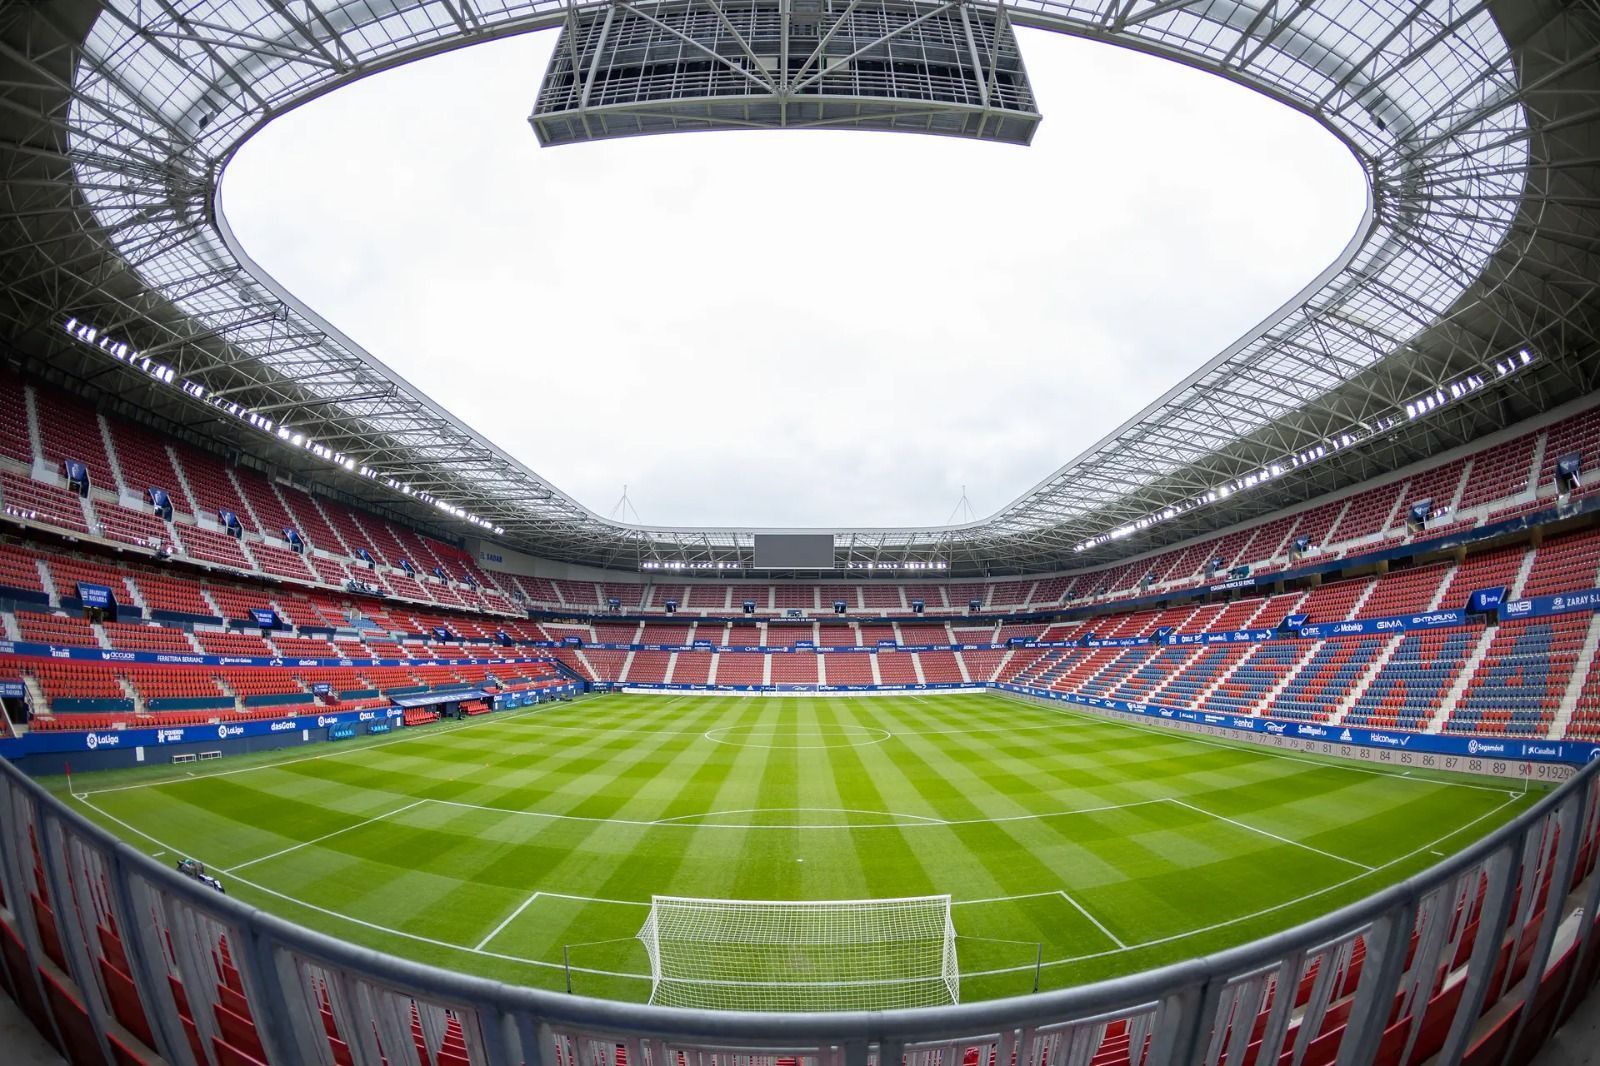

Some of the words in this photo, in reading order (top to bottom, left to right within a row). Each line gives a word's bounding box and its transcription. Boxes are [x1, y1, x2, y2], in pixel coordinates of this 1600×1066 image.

[1567, 596, 1588, 607] ZARAY
[1377, 619, 1403, 629] GIMA
[226, 726, 244, 735] LaLiga
[270, 721, 296, 731] dasGate
[98, 734, 119, 745] LaLiga
[1232, 730, 1239, 738] 75
[1259, 734, 1267, 743] 77
[1273, 736, 1282, 745] 78
[1289, 739, 1298, 748] 79
[1305, 741, 1315, 750] 80
[1322, 743, 1332, 753] 81
[1341, 746, 1351, 756] 82
[1360, 749, 1370, 759] 83
[1380, 751, 1390, 760] 84
[1400, 753, 1412, 763] 85
[1423, 755, 1435, 766] 86
[1445, 757, 1458, 768] 87
[1469, 760, 1482, 771] 88
[1492, 762, 1506, 774] 89
